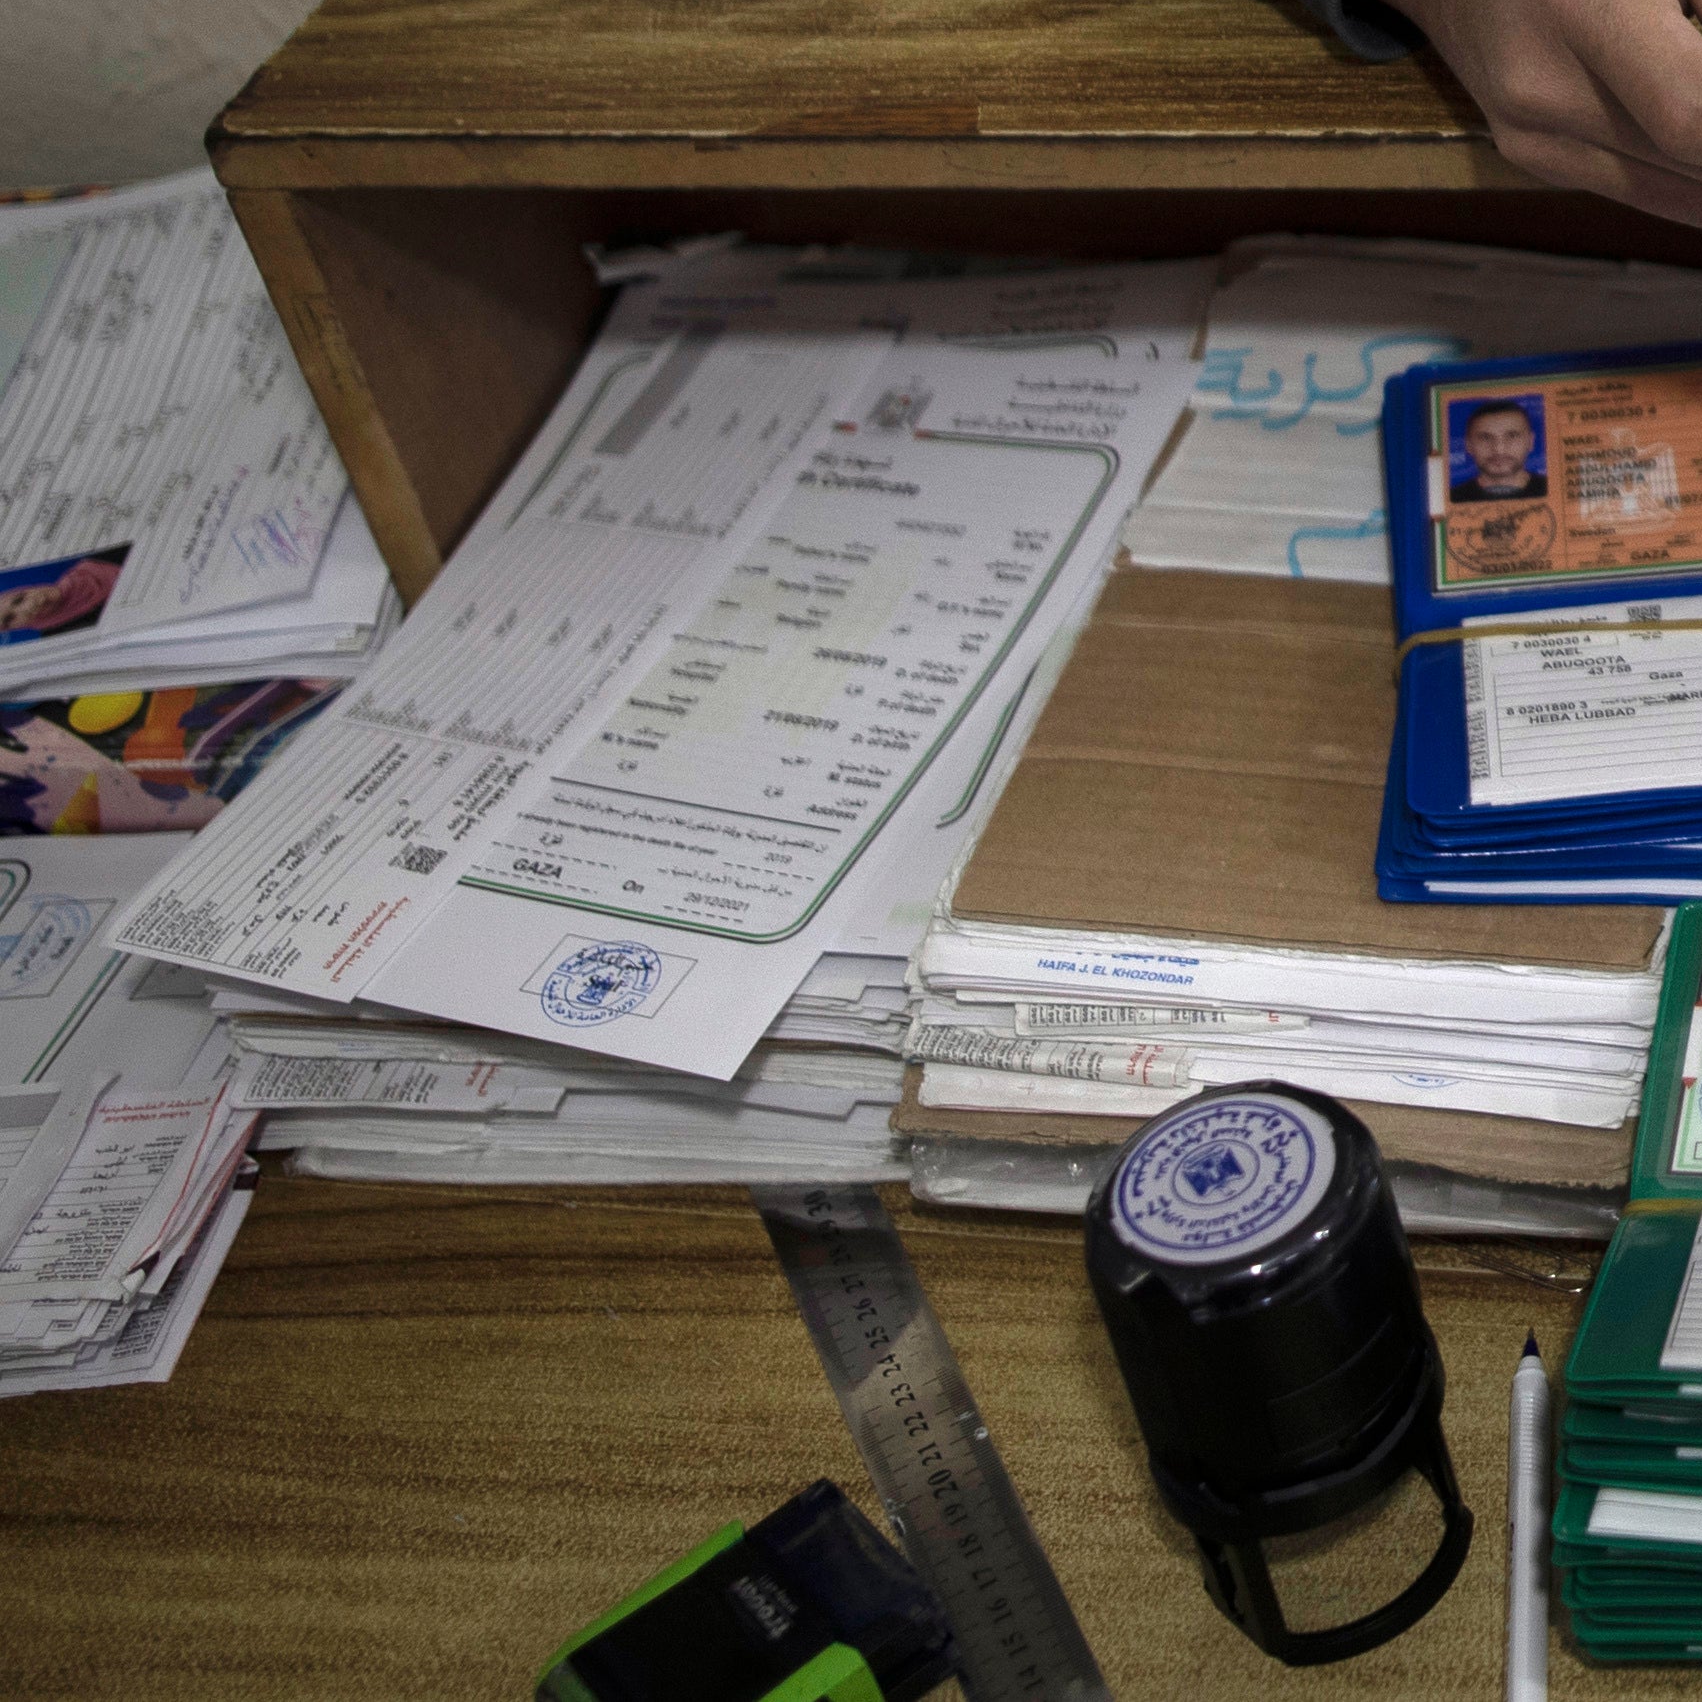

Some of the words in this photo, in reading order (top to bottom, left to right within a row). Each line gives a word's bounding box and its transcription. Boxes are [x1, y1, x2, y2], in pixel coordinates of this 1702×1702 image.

[1540, 647, 1583, 657] WAEL
[1542, 655, 1626, 670] ABUQOOTA
[1649, 669, 1683, 680] Gaza
[1528, 712, 1572, 724] HEBA
[1574, 707, 1636, 720] LUBBAD
[512, 858, 563, 879] GAZA
[622, 879, 644, 894] On
[1038, 959, 1076, 972] HAIFA
[1079, 966, 1089, 974] J.
[1092, 966, 1107, 975] EL
[1111, 967, 1194, 985] KHOZONDAR
[864, 1325, 889, 1348] 25
[878, 1352, 901, 1377] 24
[890, 1382, 916, 1407] 23
[903, 1410, 929, 1437] 22
[917, 1441, 942, 1466] 21
[927, 1468, 959, 1497] 20
[944, 1503, 968, 1528] 19
[958, 1531, 984, 1559] 18
[972, 1566, 997, 1591] 17
